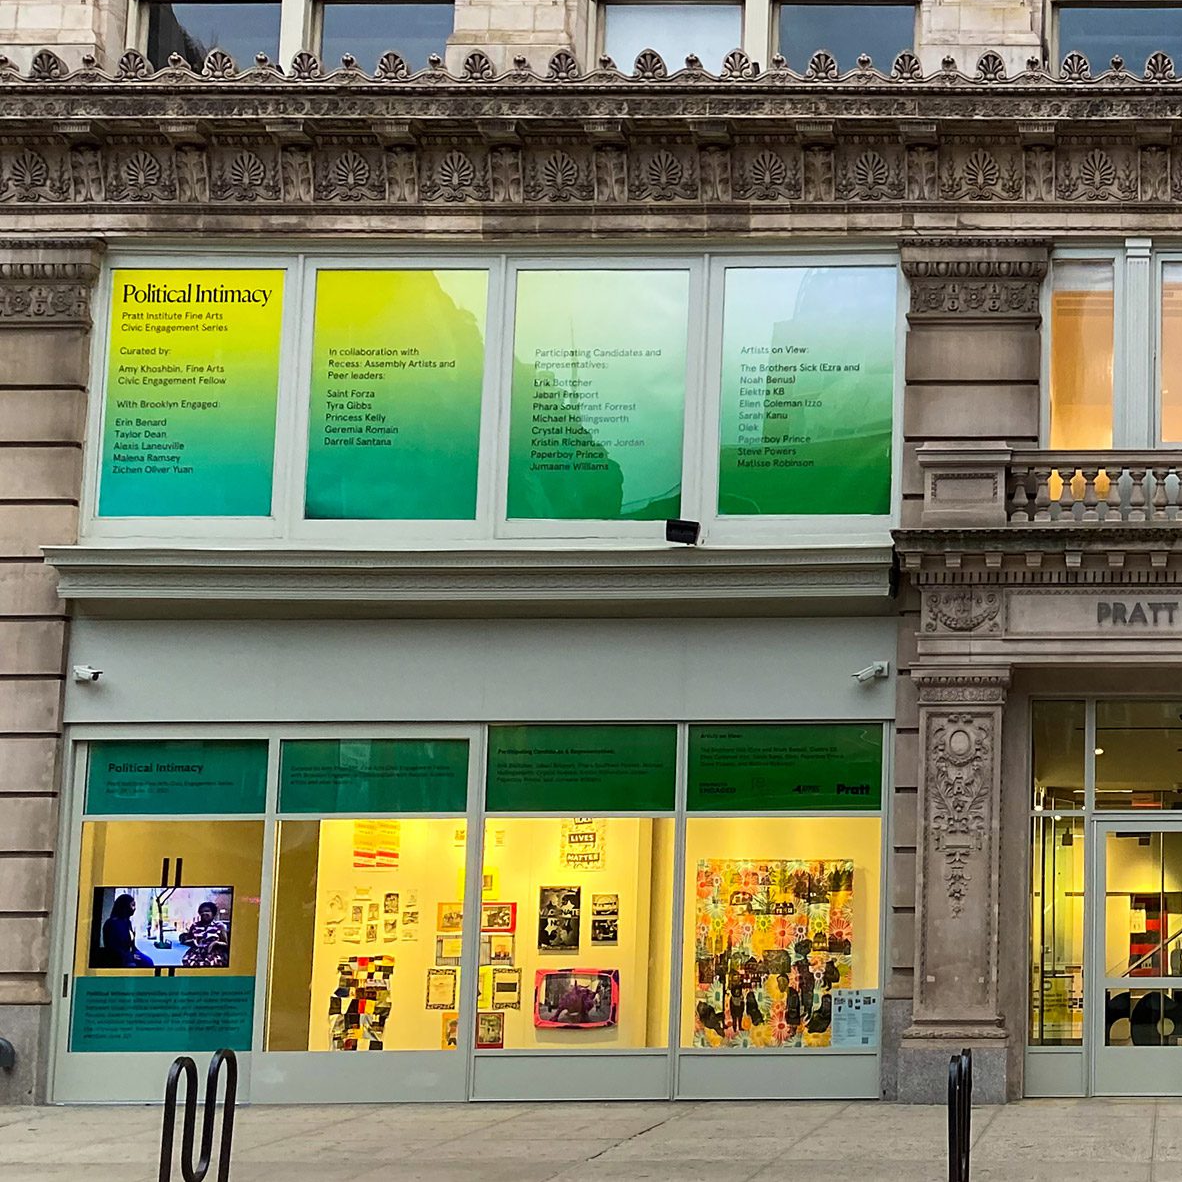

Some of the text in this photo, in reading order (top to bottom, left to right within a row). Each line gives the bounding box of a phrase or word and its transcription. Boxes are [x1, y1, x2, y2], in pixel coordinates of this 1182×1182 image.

[123, 283, 272, 307] Political Intimacy
[122, 312, 223, 320] Pratt Institute Fine Arts
[145, 324, 199, 333] Engagement
[120, 347, 171, 356] Curated by:
[329, 348, 419, 356] In collaboration with
[535, 349, 661, 358] Participating Candidates and
[741, 346, 769, 354] Artists
[785, 346, 809, 354] View:
[328, 360, 455, 369] Recess: Assembly Artists and
[534, 361, 609, 370] Representatives:
[741, 363, 860, 373] The Brothers Sick (Ezra and
[118, 365, 137, 374] Amy
[328, 371, 385, 379] Peer leaders:
[143, 377, 196, 386] Engagement
[534, 379, 593, 387] Erik Bottcher
[740, 376, 763, 384] Noah
[326, 390, 375, 398] Saint Forza
[533, 391, 599, 400] Jabari Brisport
[117, 400, 220, 409] With Brooklyn Engaged:
[326, 401, 372, 411] Tyra Gibbs
[533, 403, 558, 411] Phara
[605, 403, 636, 411] Forrest
[763, 400, 802, 408] Coleman
[325, 414, 386, 423] Princess Kelly
[739, 411, 788, 419] Sarah Kanu
[115, 418, 167, 426] Erin Benard
[532, 415, 629, 425] Michael Hollingsworth
[115, 430, 166, 439] Taylor Dean
[365, 426, 399, 434] Romain
[531, 426, 600, 436] Crystal Hudson
[324, 437, 392, 446] Darrell Santana
[531, 438, 645, 447] Kristin Richardson Jordan
[738, 435, 811, 445] Paperboy Prince
[113, 442, 139, 450] Alexis
[530, 450, 604, 460] Paperboy Prince
[737, 447, 797, 456] Steve Powers
[113, 454, 180, 463] Malena Ramsey
[773, 459, 814, 467] Robinson
[145, 466, 170, 474] Oliver
[173, 466, 193, 474] Yuan
[573, 462, 609, 471] Williams
[1097, 602, 1179, 625] PRATT
[108, 763, 204, 774] Political Intimacy
[836, 783, 871, 795] Pratt
[570, 834, 594, 842] LIVES
